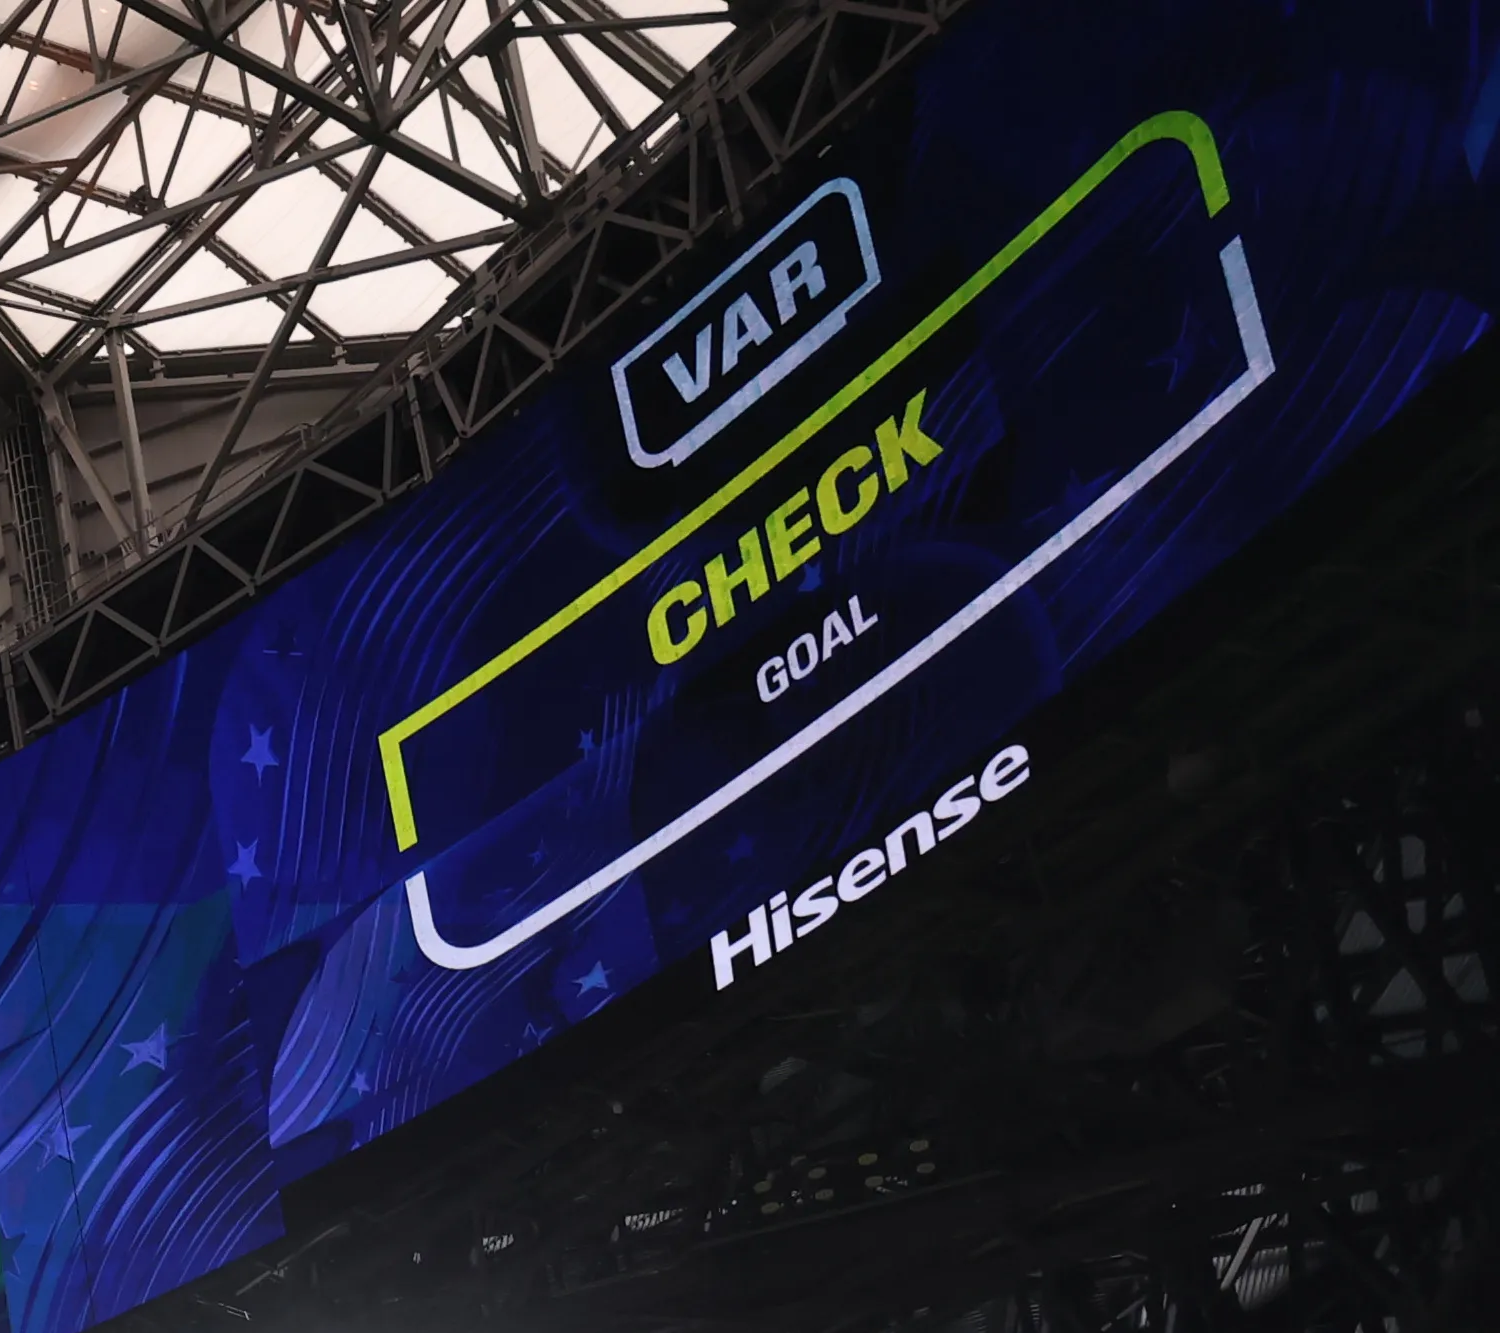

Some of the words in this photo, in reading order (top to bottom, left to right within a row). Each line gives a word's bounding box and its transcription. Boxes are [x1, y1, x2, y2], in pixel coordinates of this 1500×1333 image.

[662, 239, 827, 403] VAR
[645, 388, 943, 665] CHECK
[755, 595, 878, 703] GOAL
[709, 744, 1030, 991] Hisense
